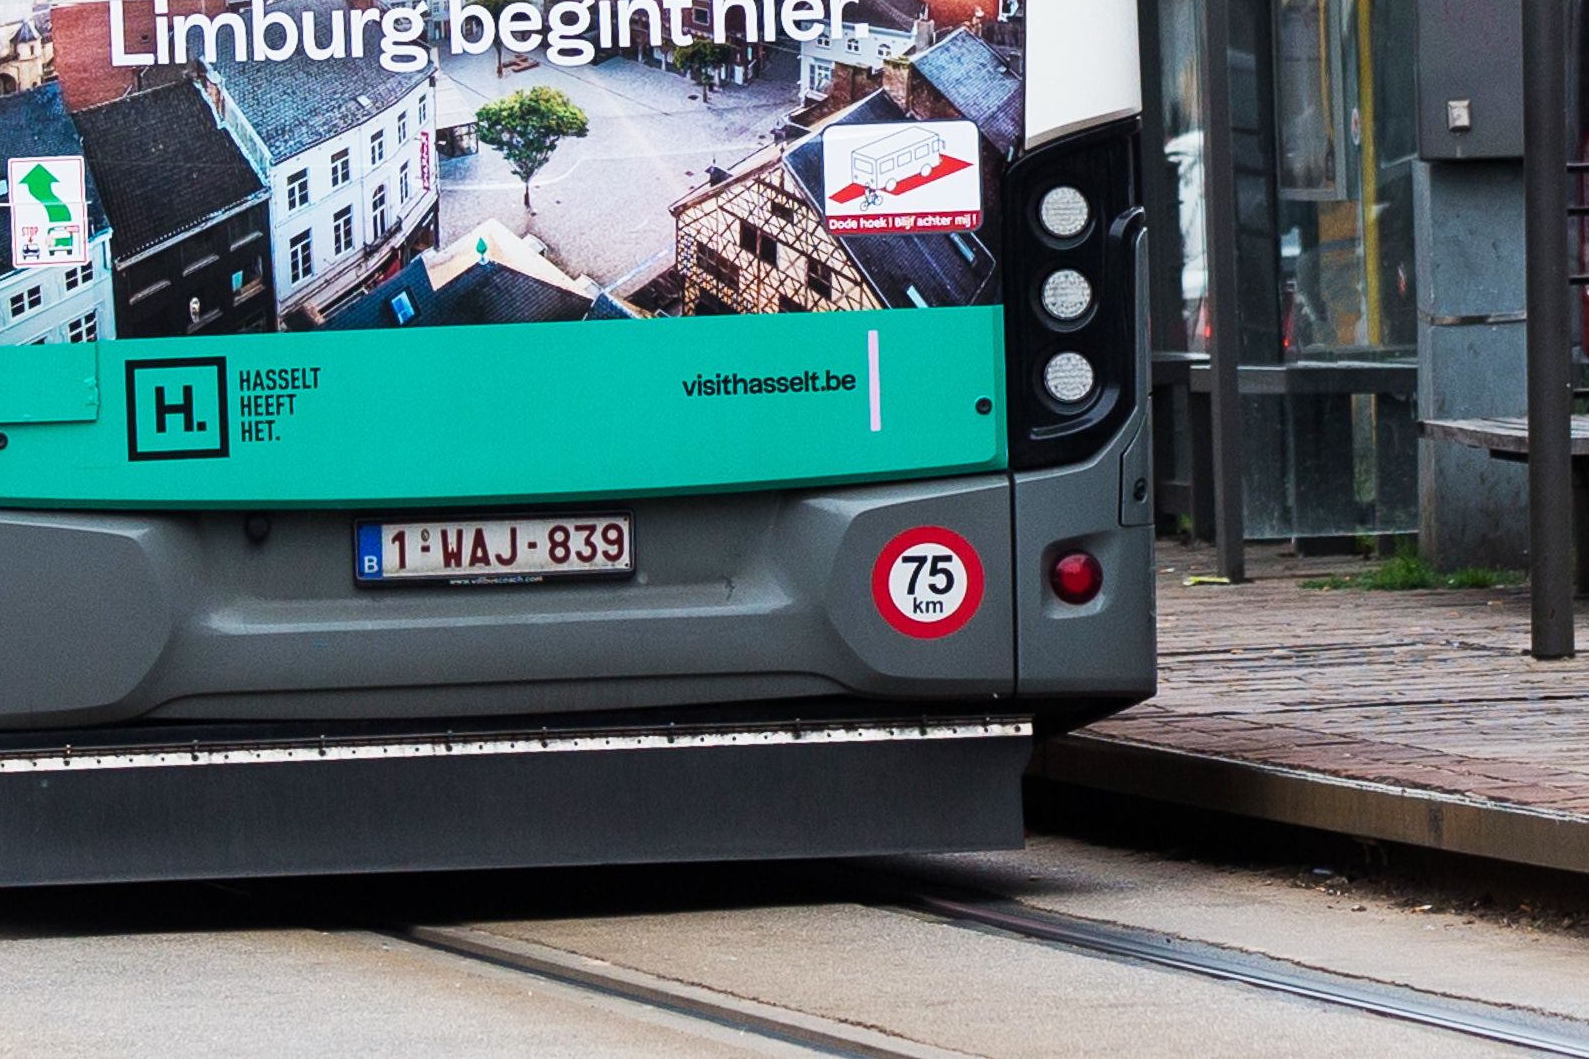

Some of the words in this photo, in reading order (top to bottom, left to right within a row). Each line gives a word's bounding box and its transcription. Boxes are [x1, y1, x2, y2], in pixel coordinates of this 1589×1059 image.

[22, 226, 39, 237] STOP
[829, 218, 857, 230] Dode
[860, 217, 887, 229] hoek
[894, 216, 916, 230] Blijf
[917, 215, 952, 227] achter
[955, 214, 972, 228] mij
[239, 368, 321, 391] HASSELT
[682, 369, 856, 397] visithasselt.be
[240, 393, 297, 417] HEEFT
[241, 420, 280, 442] HET.
[363, 556, 379, 574] B
[901, 554, 955, 596] 75
[913, 597, 944, 614] km
